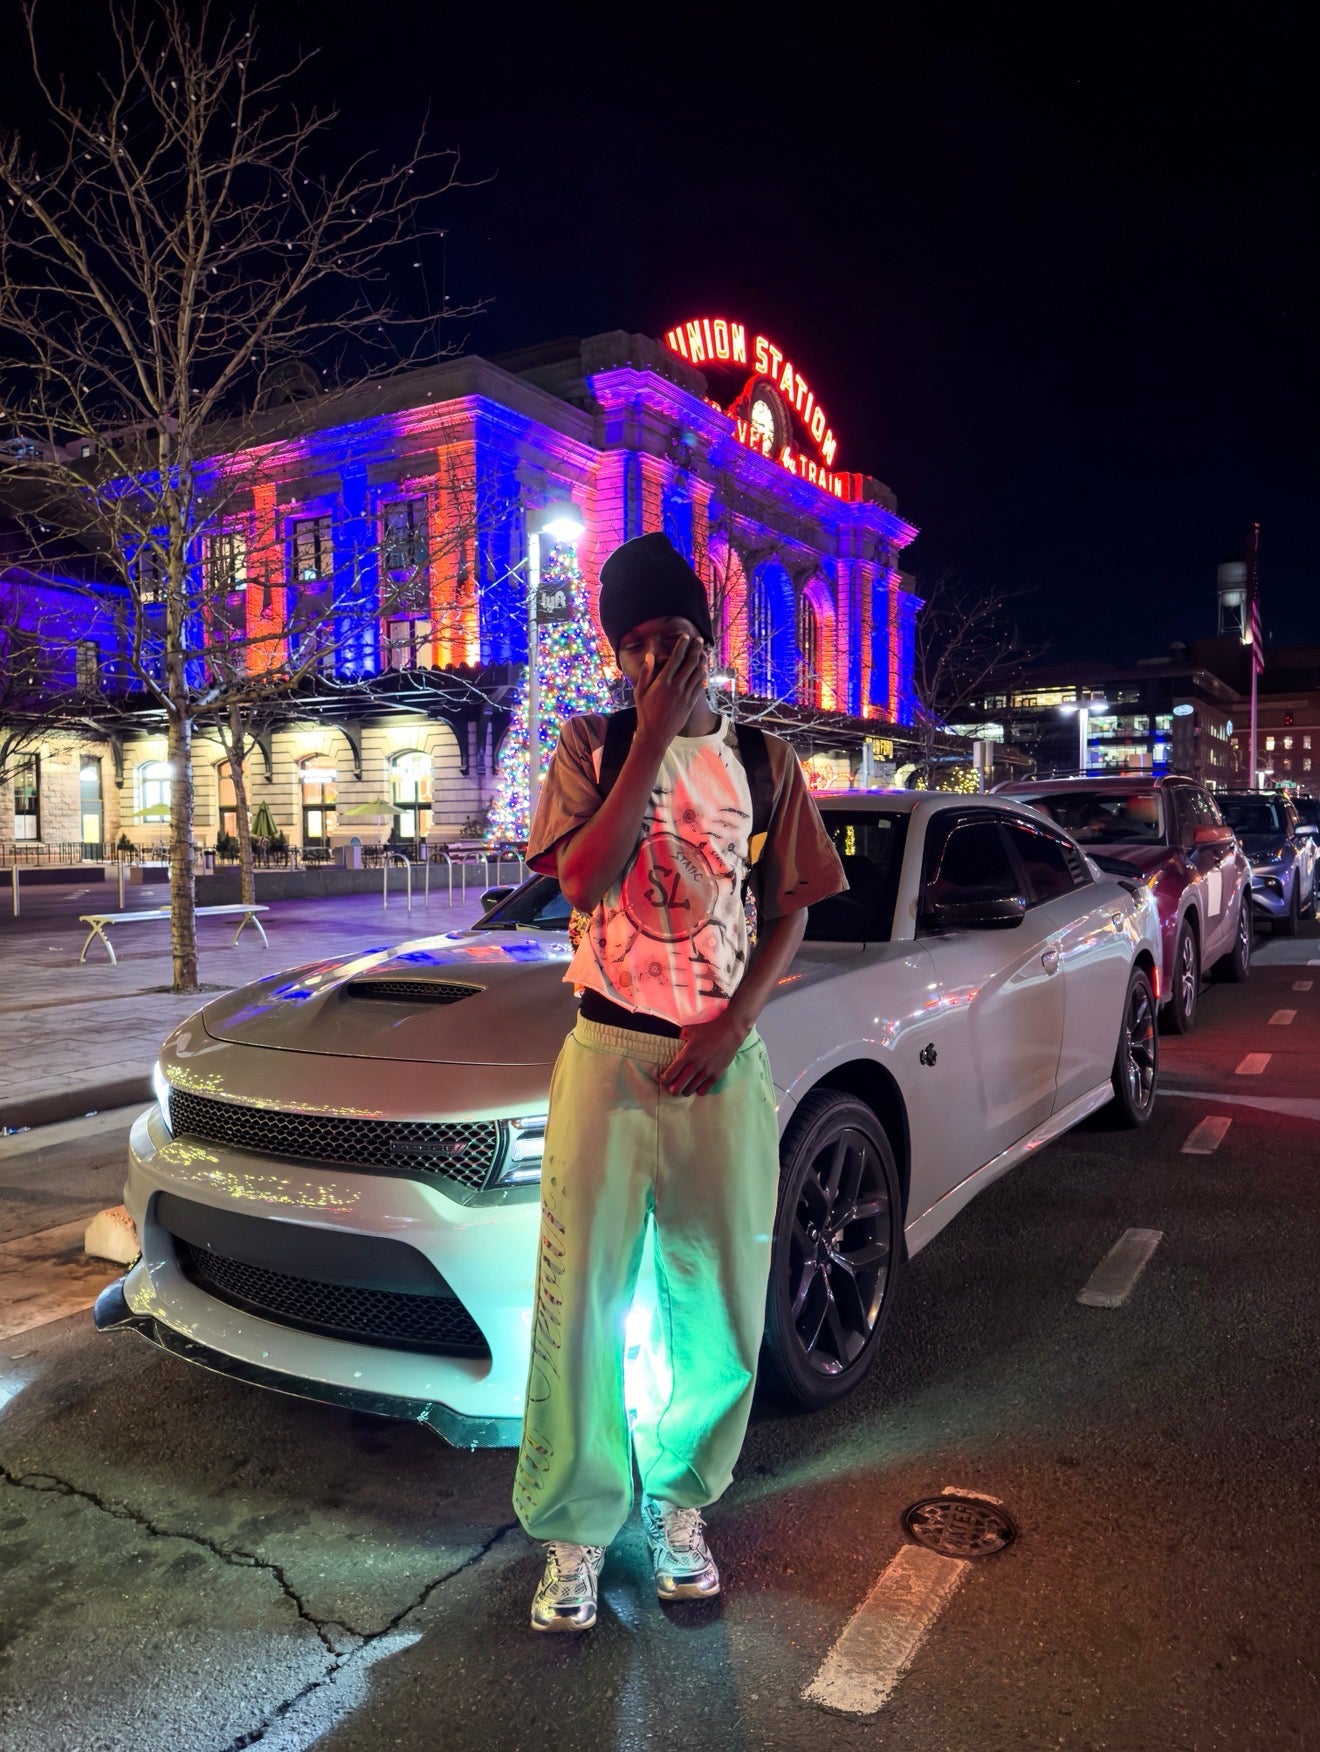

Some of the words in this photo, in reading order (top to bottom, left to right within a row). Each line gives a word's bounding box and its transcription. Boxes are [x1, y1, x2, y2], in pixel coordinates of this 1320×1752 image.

[667, 318, 747, 364] UNION
[754, 335, 838, 467] STATION
[799, 454, 843, 499] TRAIN
[643, 863, 691, 911] SL
[669, 850, 704, 883] STATIC
